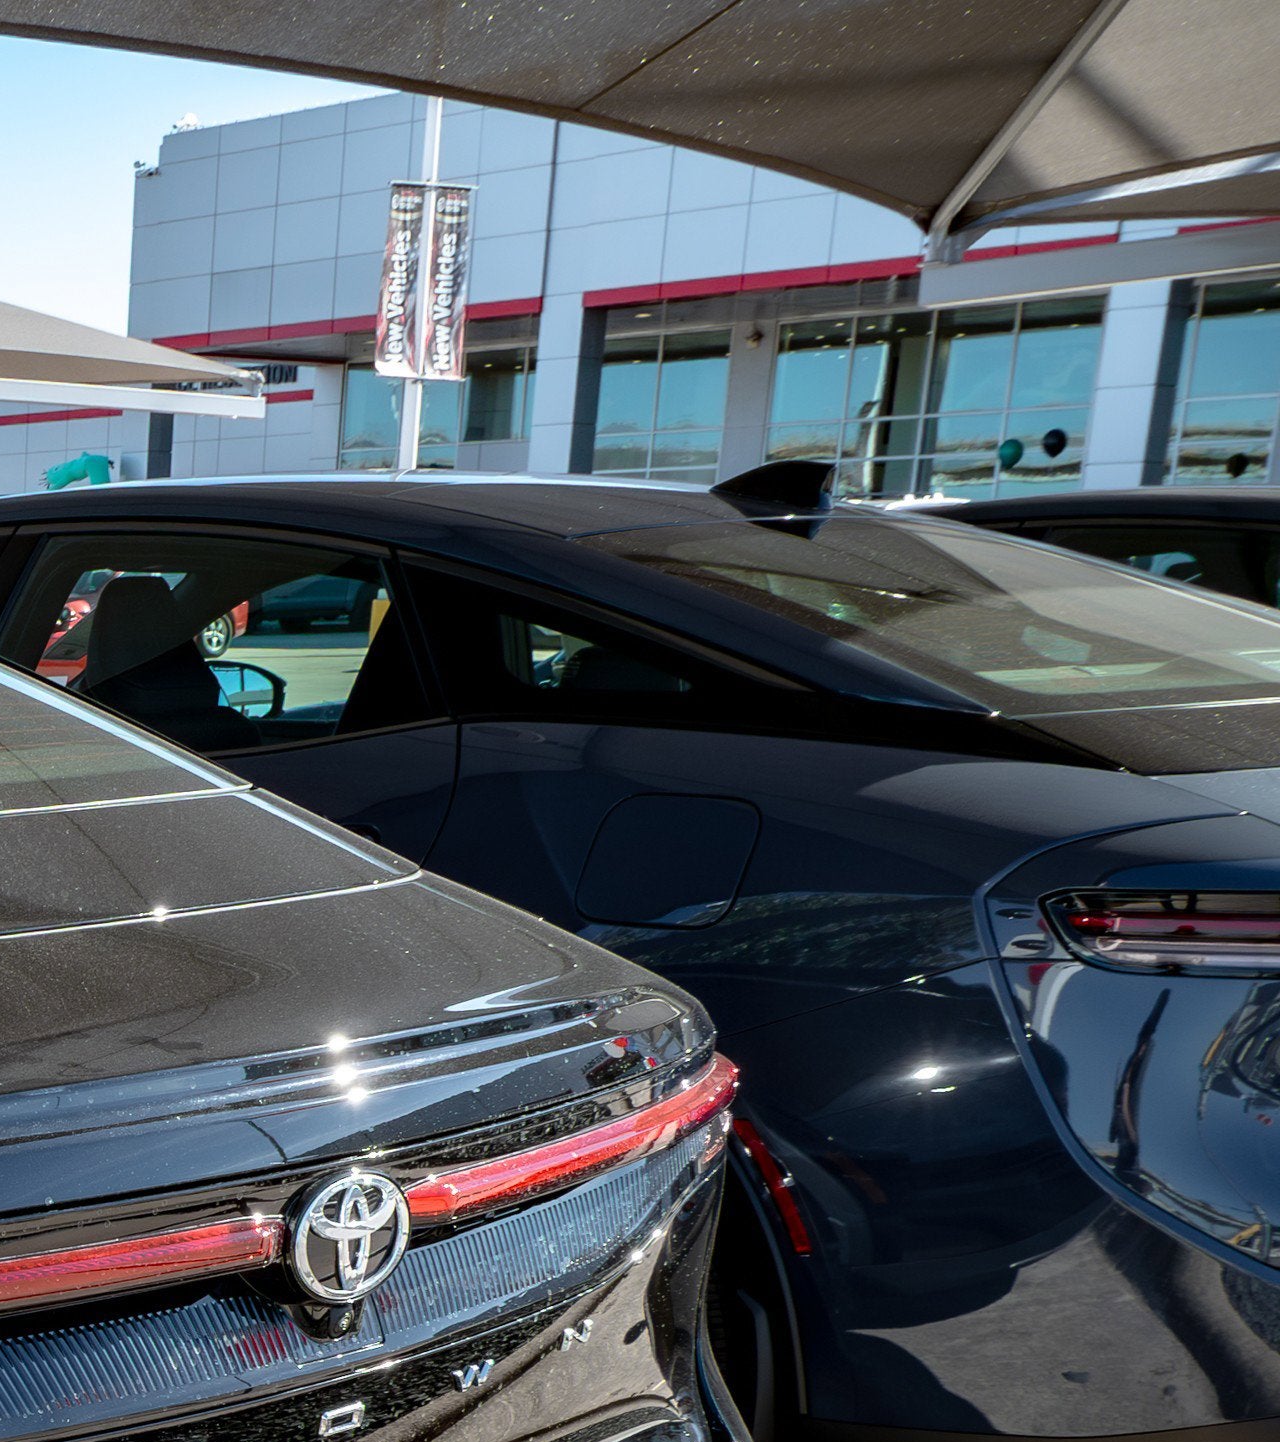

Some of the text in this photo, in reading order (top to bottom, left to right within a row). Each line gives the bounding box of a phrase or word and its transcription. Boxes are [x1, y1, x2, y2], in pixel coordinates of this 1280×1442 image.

[386, 229, 412, 319] Vehicles
[432, 232, 458, 322] Vehicles
[385, 321, 407, 364] New
[432, 323, 452, 371] New
